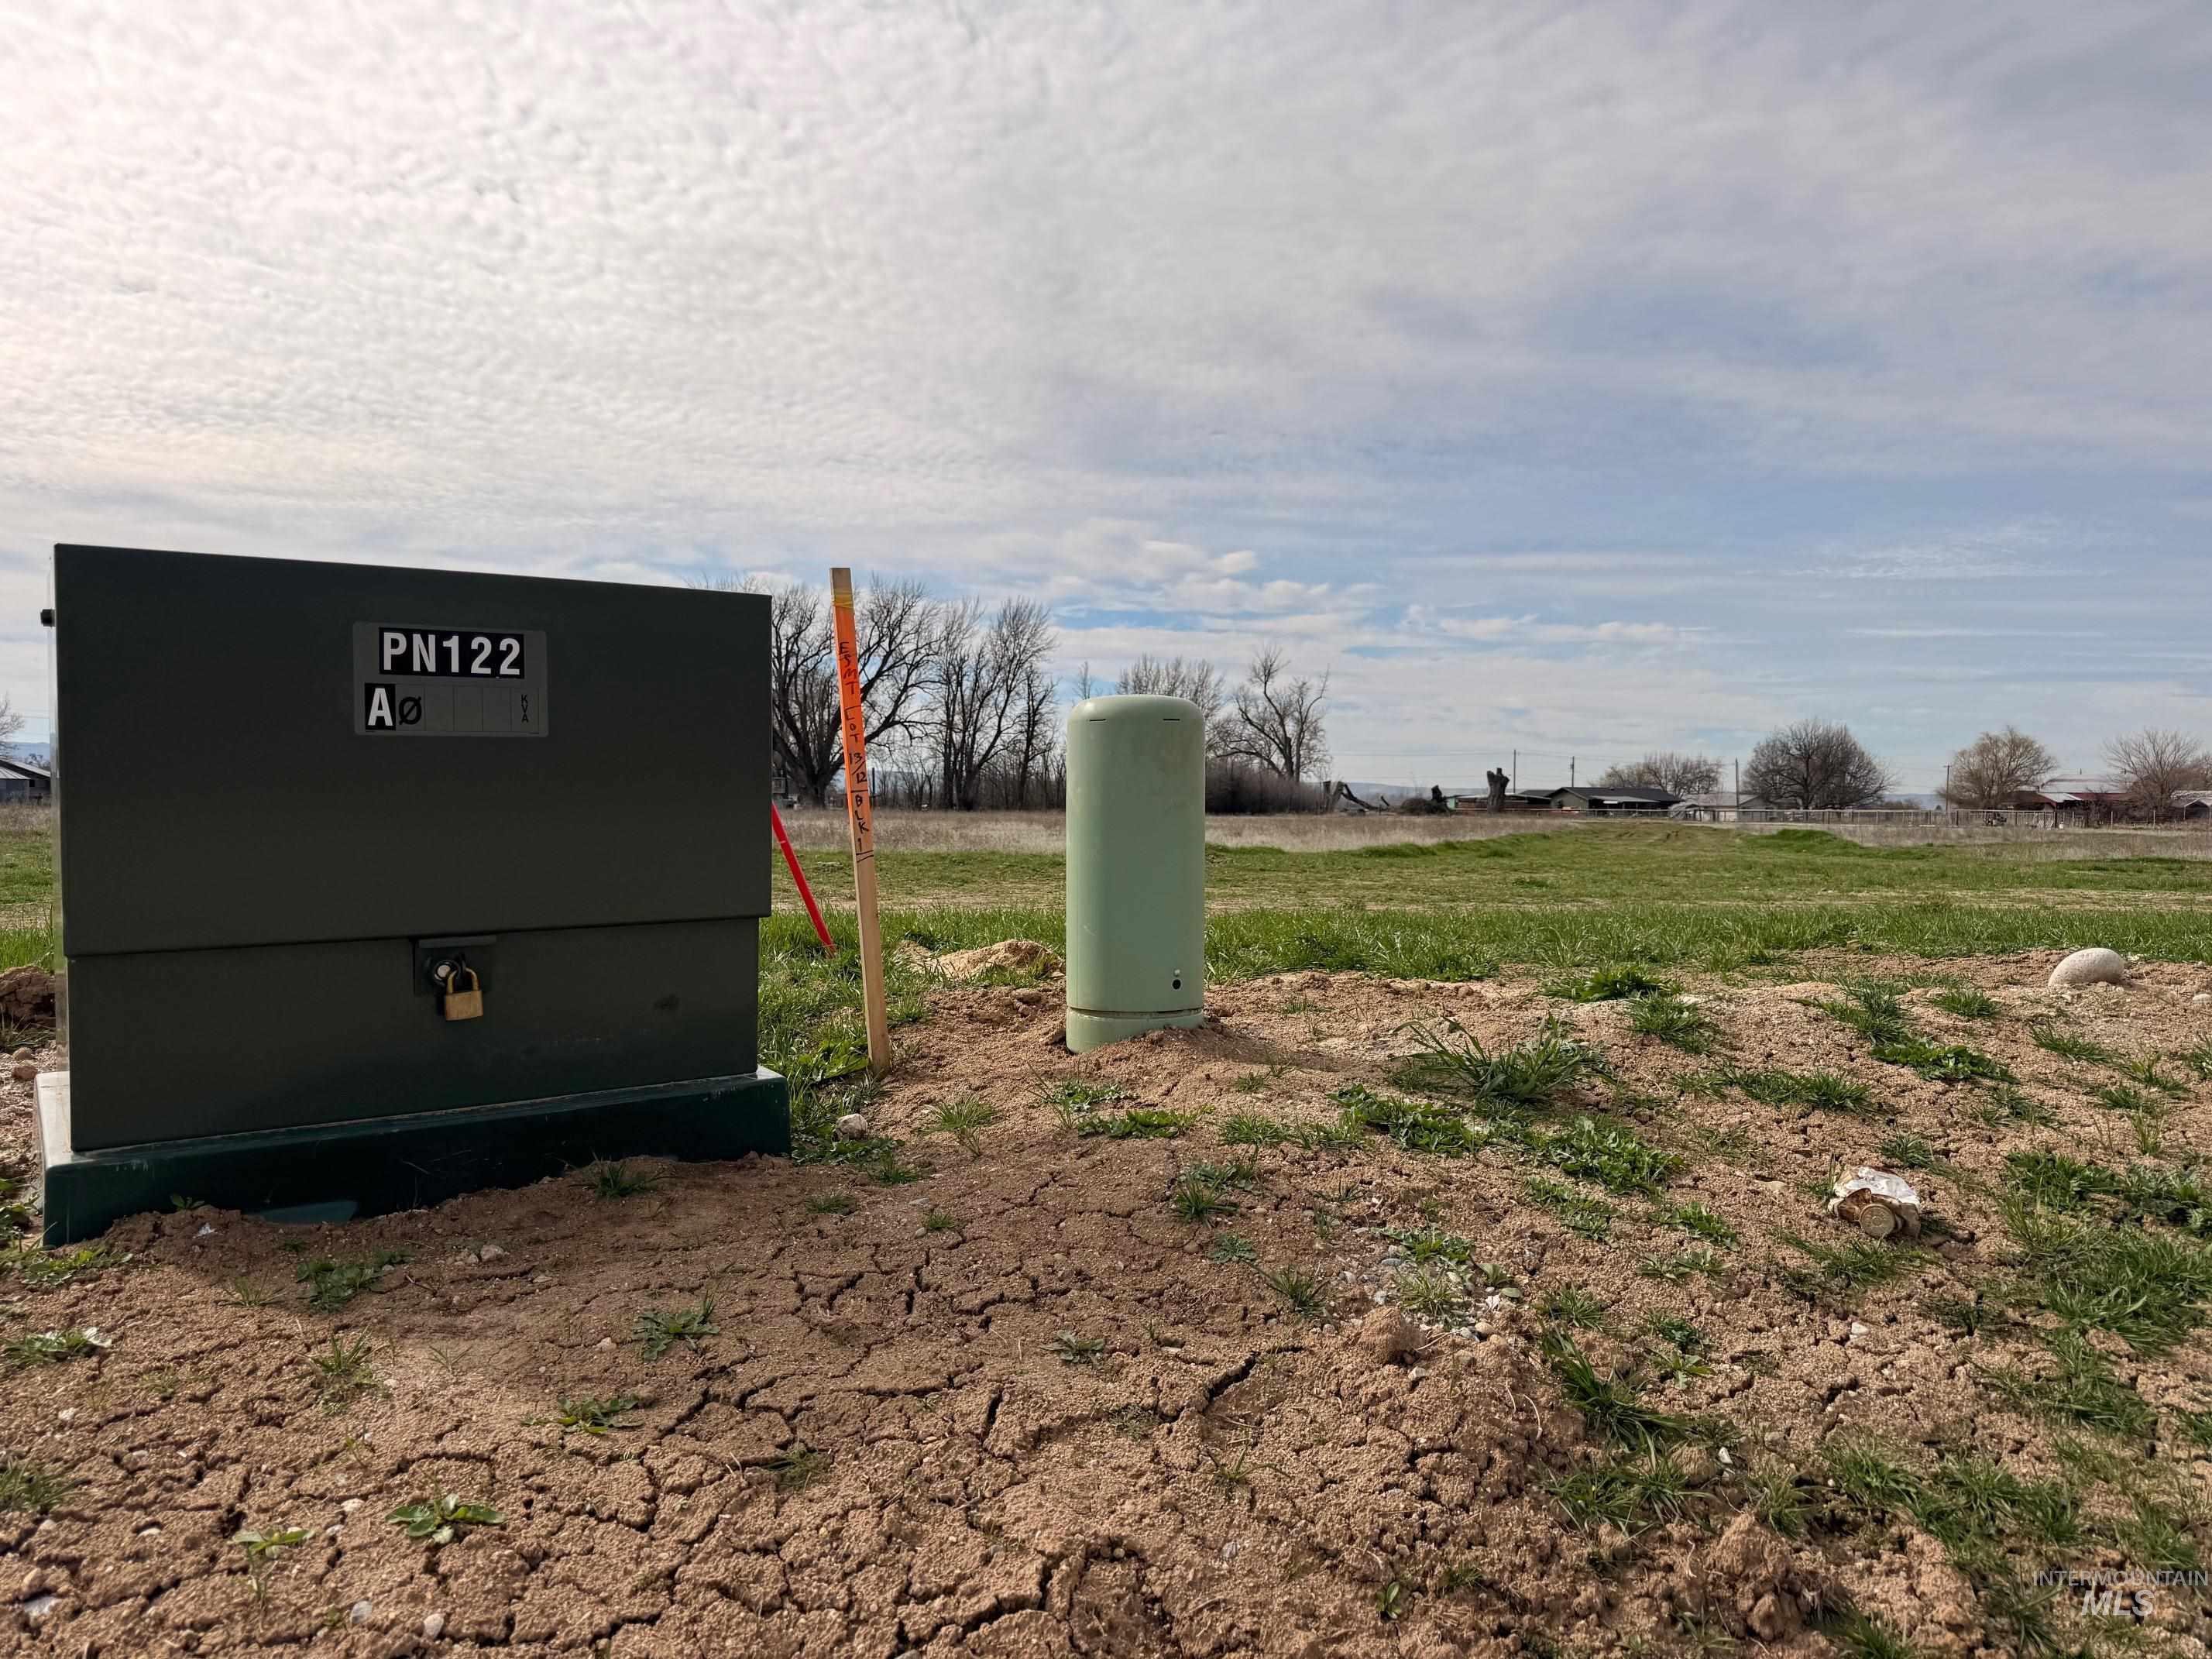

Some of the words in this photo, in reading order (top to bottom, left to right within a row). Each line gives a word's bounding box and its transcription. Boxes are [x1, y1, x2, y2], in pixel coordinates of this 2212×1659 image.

[383, 631, 520, 675] PN122
[844, 707, 861, 744] LOT
[854, 795, 870, 834] BLK
